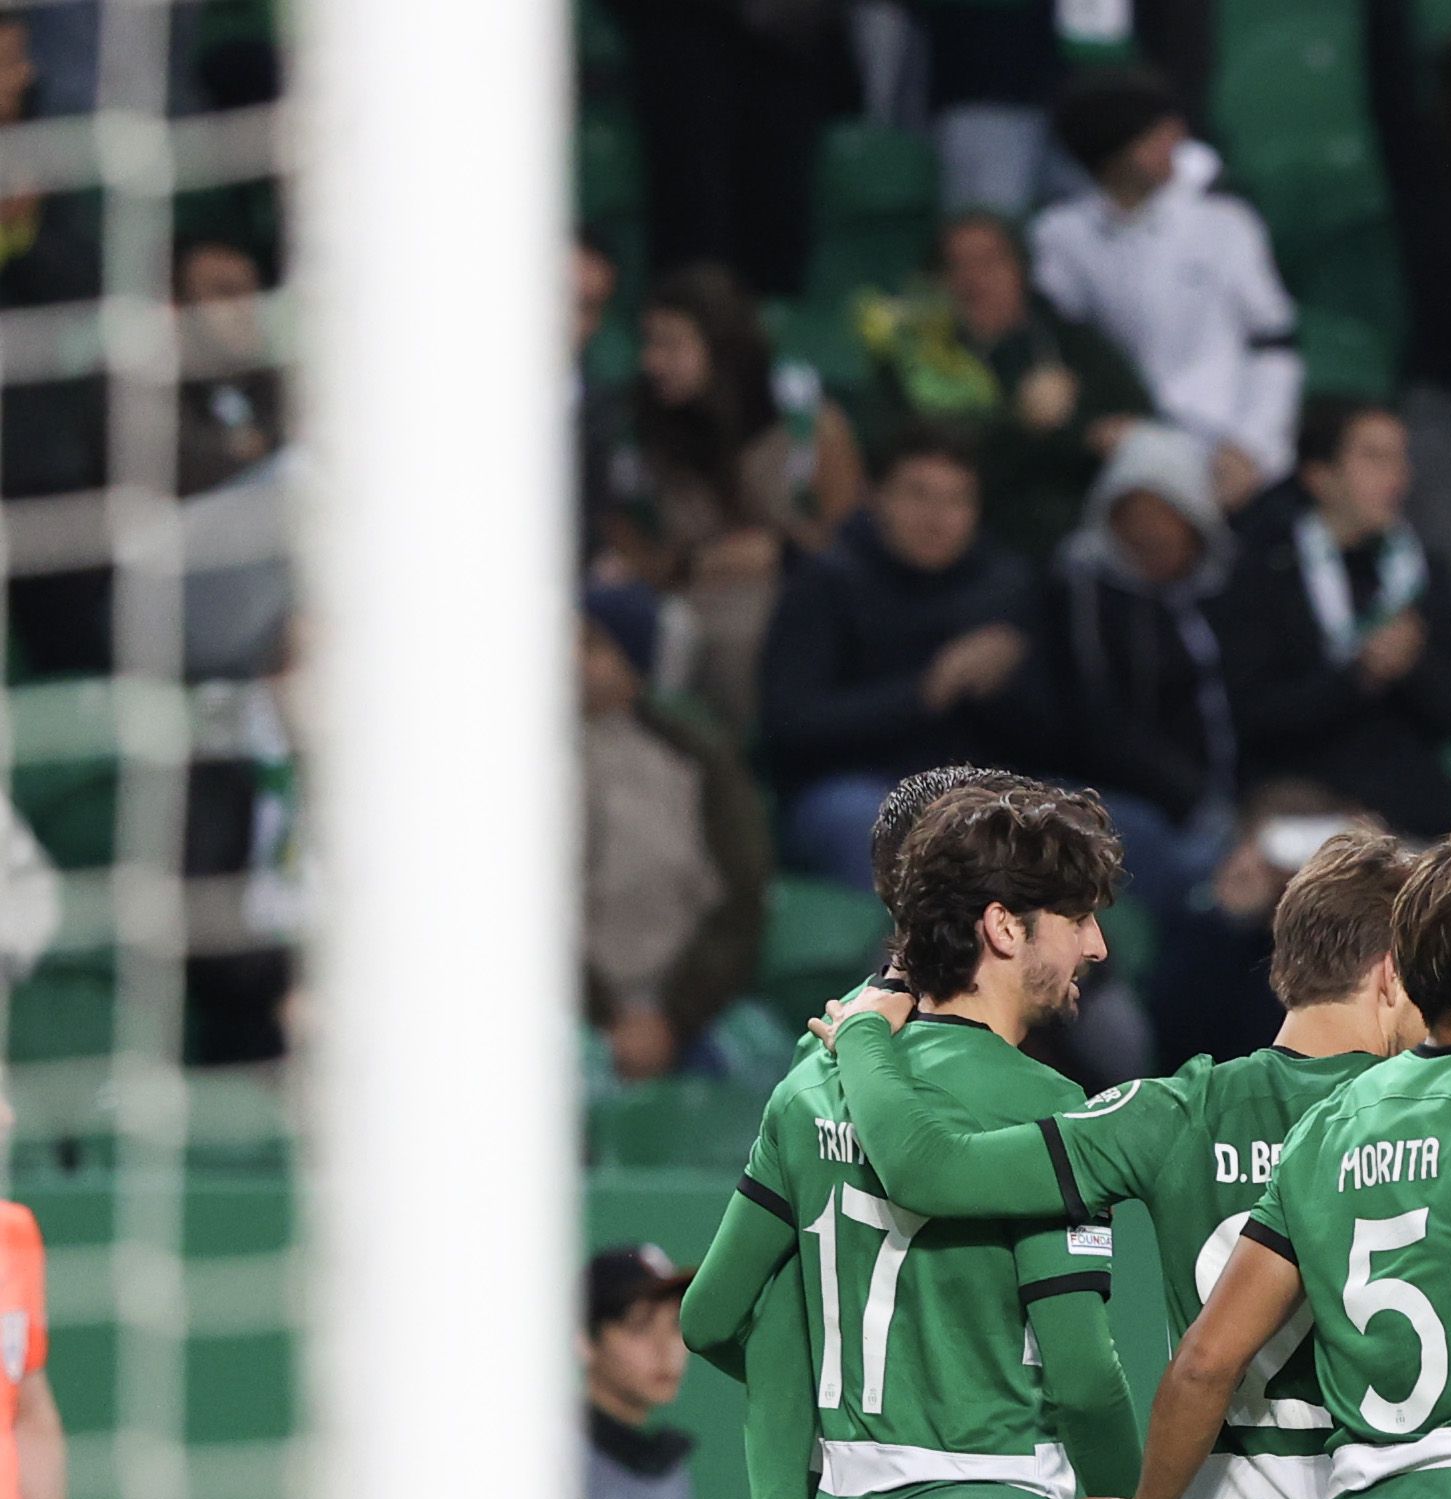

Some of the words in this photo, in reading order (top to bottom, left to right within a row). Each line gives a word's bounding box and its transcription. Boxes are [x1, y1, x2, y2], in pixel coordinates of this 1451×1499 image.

[1338, 1136, 1440, 1193] MORITA
[802, 1181, 932, 1414] 17
[1343, 1207, 1448, 1434] 5
